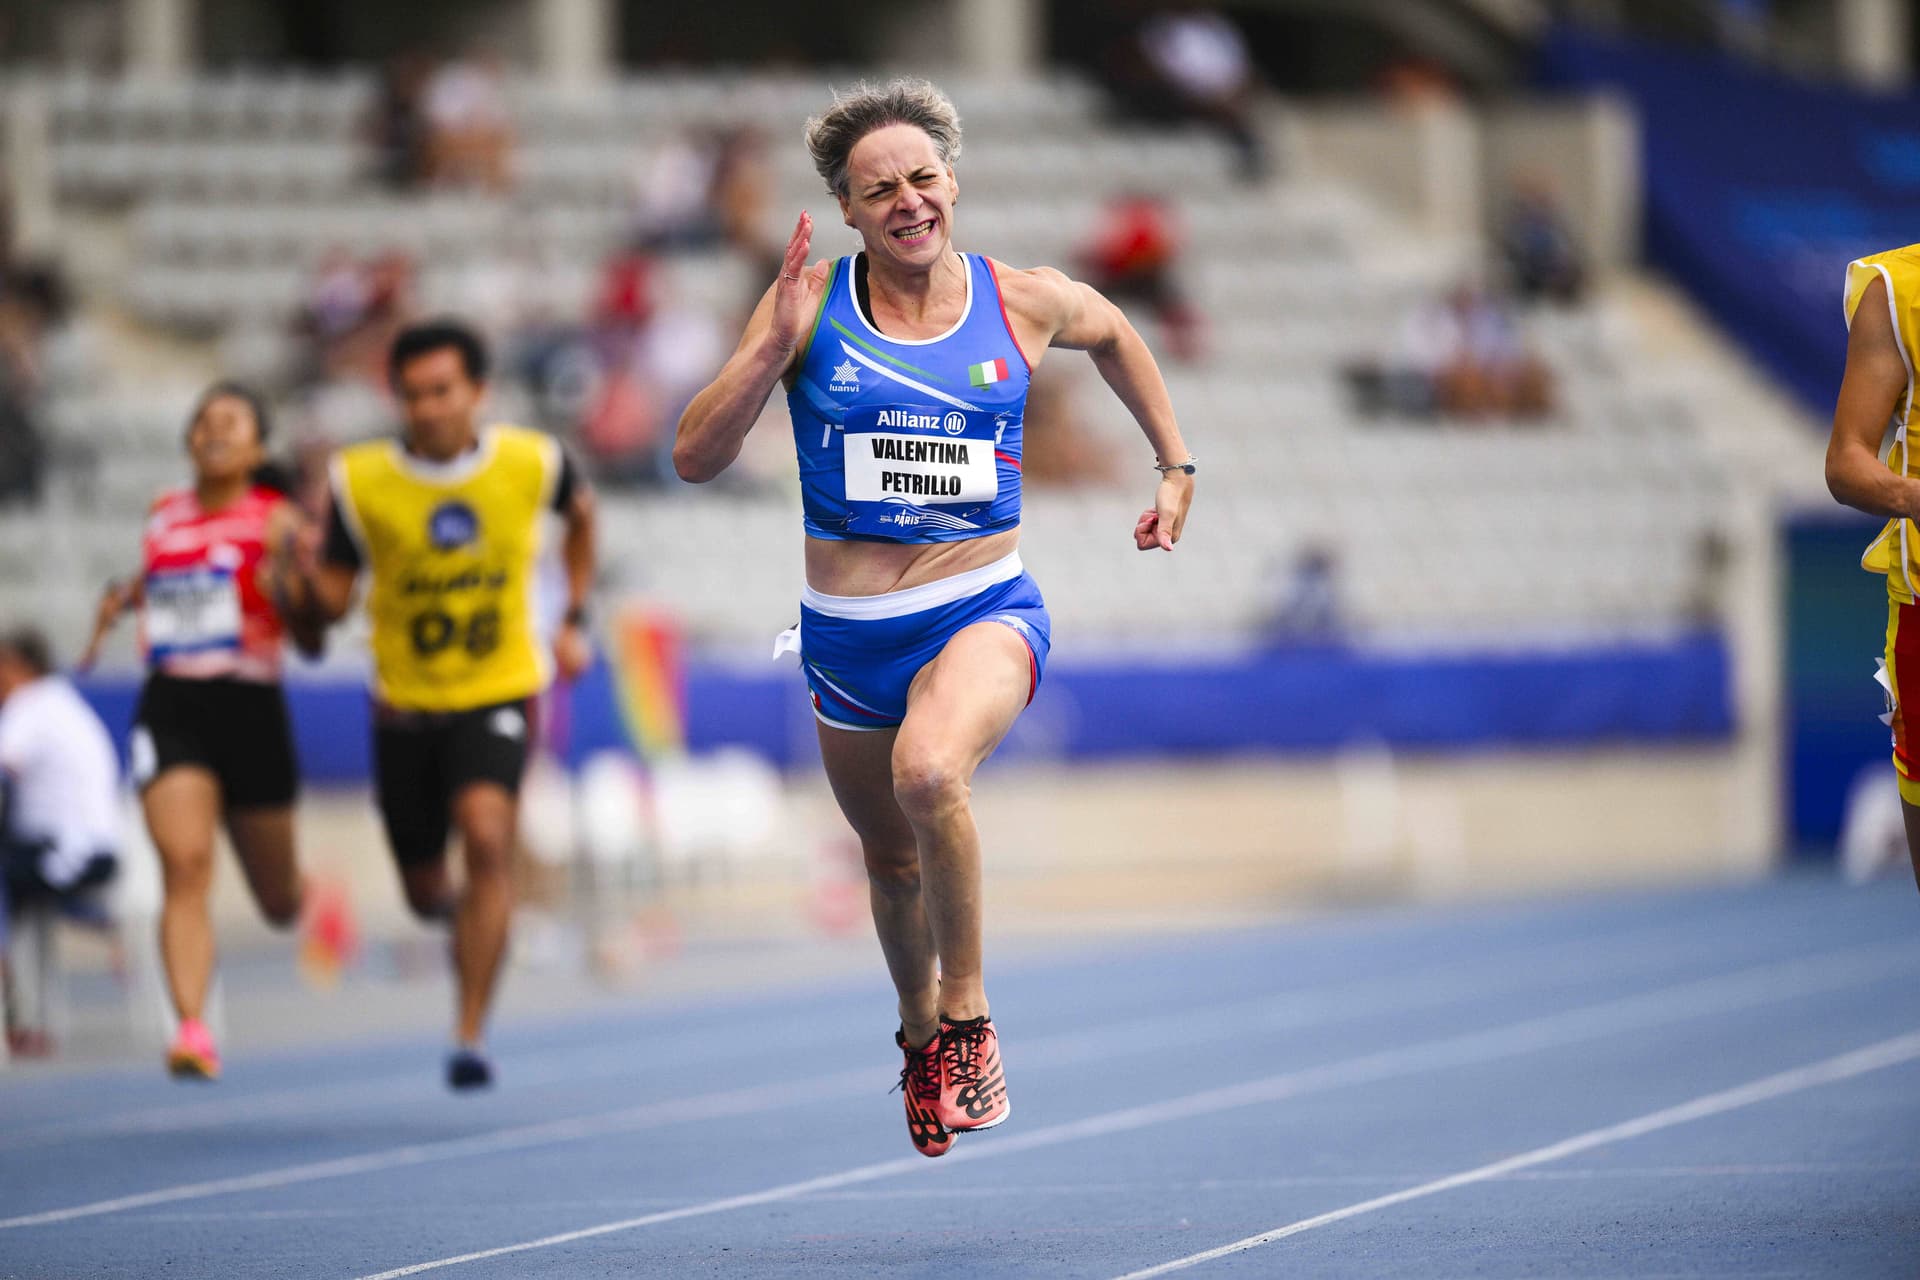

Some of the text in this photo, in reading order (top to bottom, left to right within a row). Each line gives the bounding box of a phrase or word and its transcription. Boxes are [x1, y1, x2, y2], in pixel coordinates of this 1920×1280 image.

[829, 383, 860, 392] luanvi
[876, 410, 941, 430] Allianz
[871, 438, 970, 465] VALENTINA
[881, 471, 962, 496] PETRILLO
[894, 509, 920, 527] PARIS
